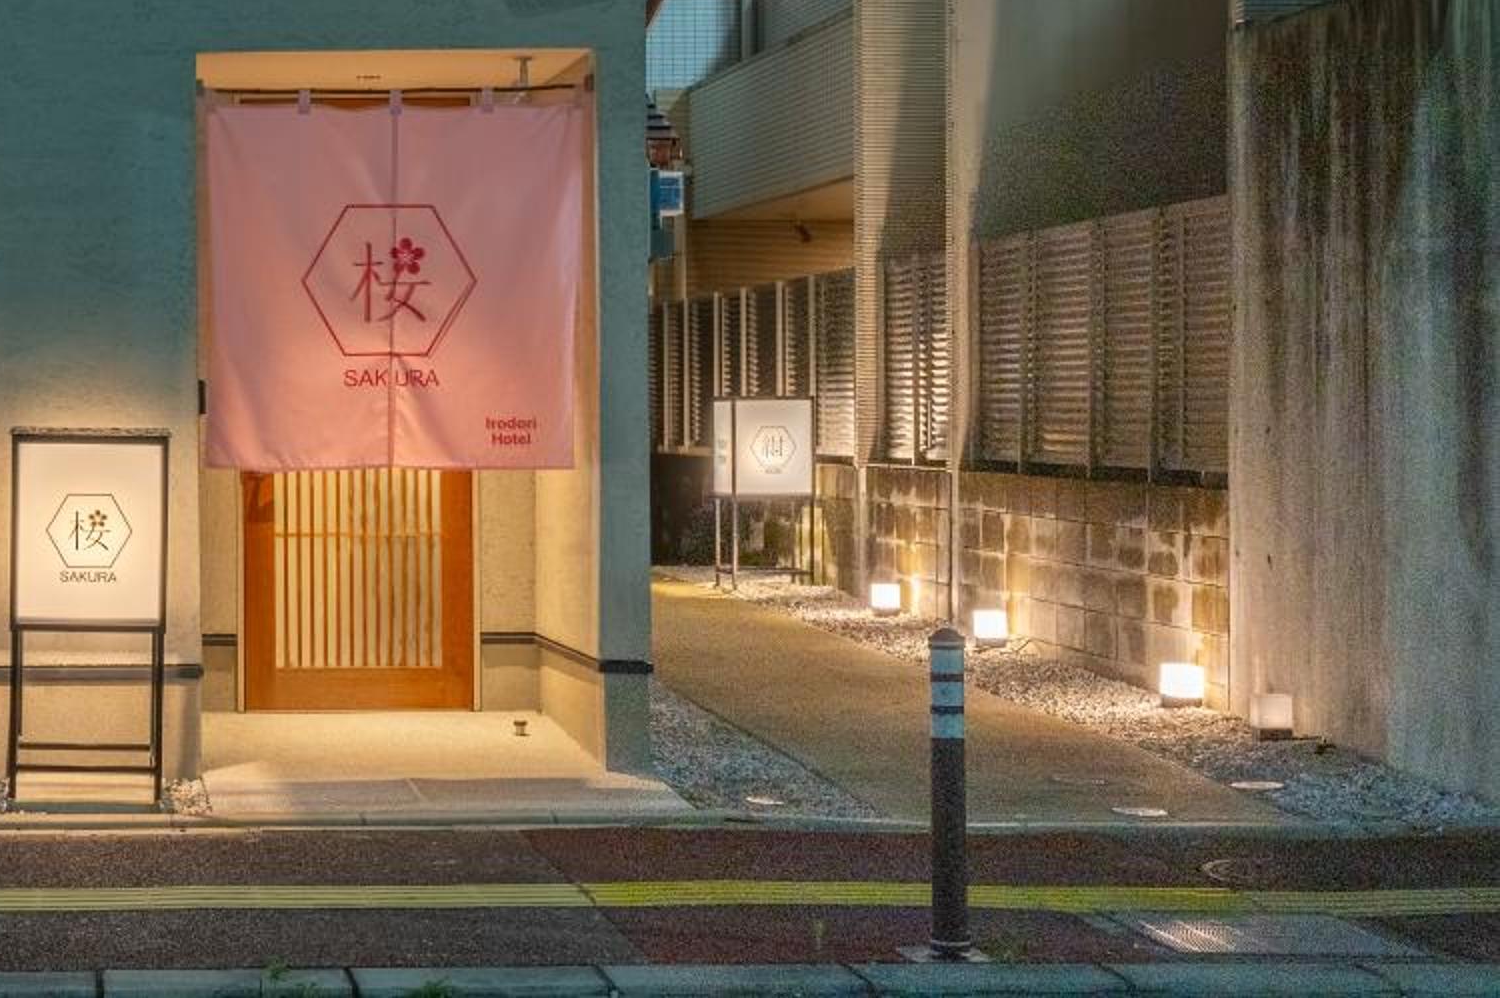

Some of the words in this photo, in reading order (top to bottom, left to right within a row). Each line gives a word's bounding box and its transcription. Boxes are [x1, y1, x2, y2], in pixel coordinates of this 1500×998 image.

[349, 237, 433, 323] 桜
[343, 369, 440, 388] SAKURA
[485, 416, 537, 430] Irodori
[491, 433, 531, 445] Hotel
[67, 509, 112, 551] 桜
[59, 571, 117, 583] SAKURA
